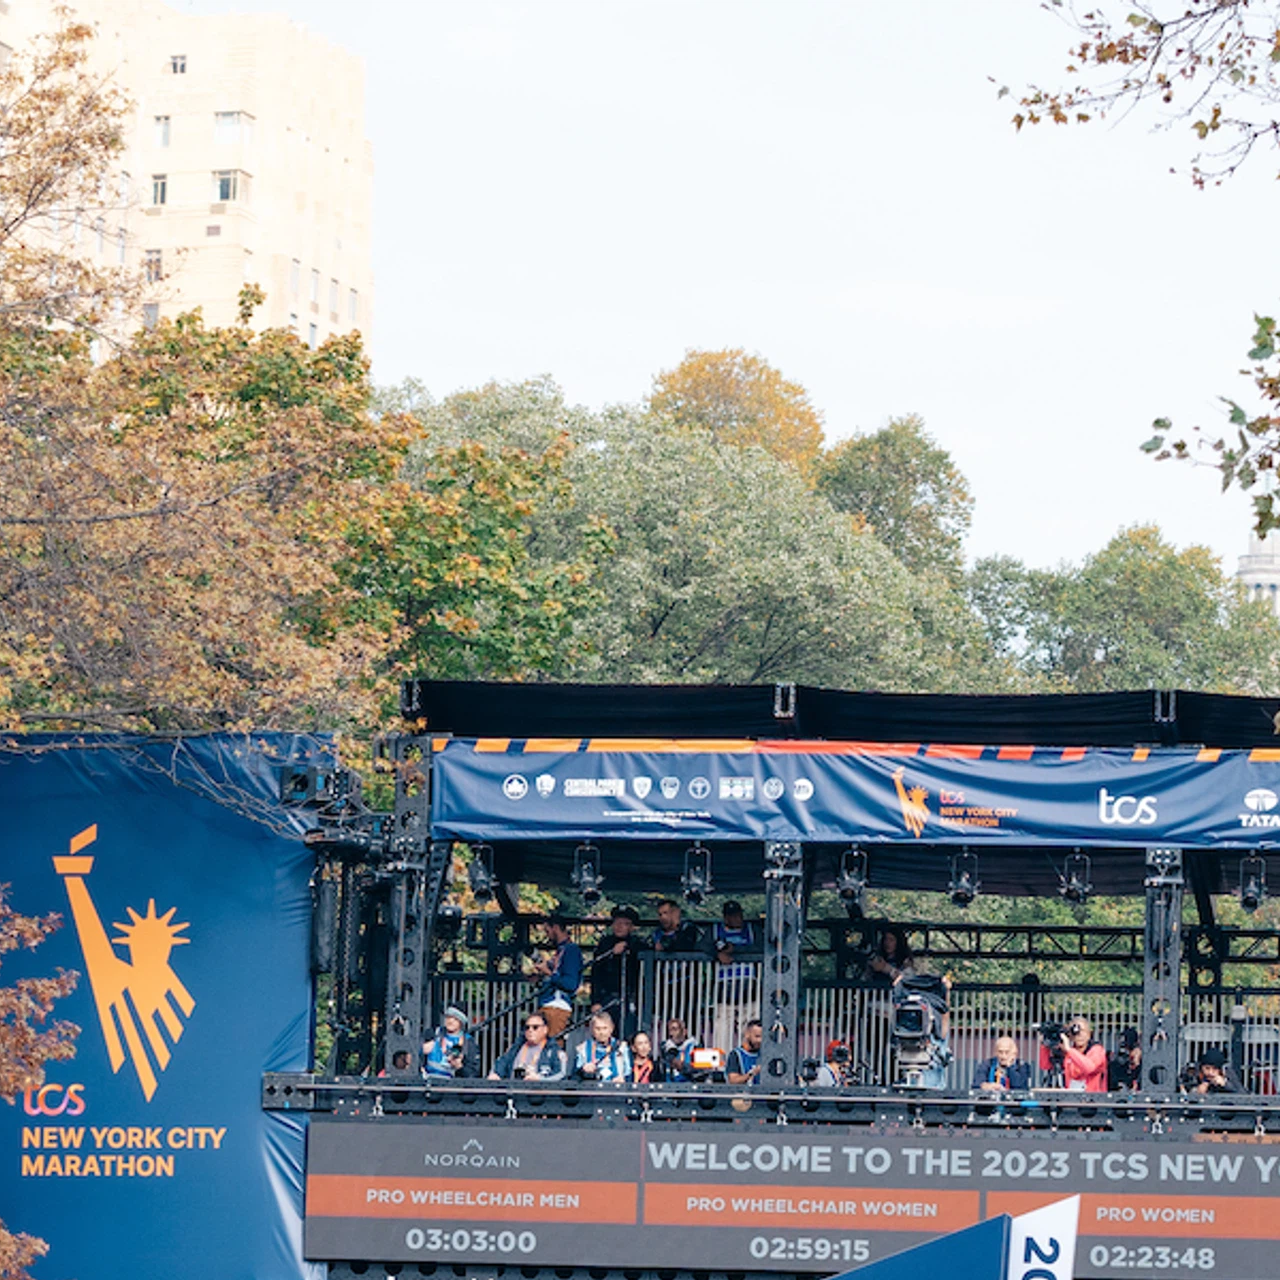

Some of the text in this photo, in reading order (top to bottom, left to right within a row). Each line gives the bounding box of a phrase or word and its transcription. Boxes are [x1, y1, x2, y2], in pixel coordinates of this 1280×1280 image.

[1099, 787, 1158, 825] tcs
[23, 1083, 86, 1116] tcs
[22, 1127, 227, 1149] NEW YORK CITY
[21, 1155, 175, 1177] MARATHON
[424, 1154, 520, 1168] NORQAIN
[648, 1142, 831, 1173] WELCOME
[842, 1147, 892, 1174] TO
[901, 1149, 972, 1176] THE
[981, 1150, 1070, 1178] 2023
[1080, 1153, 1149, 1181] TCS
[1160, 1154, 1244, 1183] NEW
[366, 1189, 580, 1209] PRO WHEELCHAIR MEN
[687, 1197, 937, 1217] PRO WHEELCHAIR WOMEN
[1096, 1207, 1215, 1224] PRO WOMEN
[405, 1228, 537, 1253] 03:03:00
[749, 1236, 869, 1261] 02:59:15
[1089, 1245, 1216, 1270] 02:23:48
